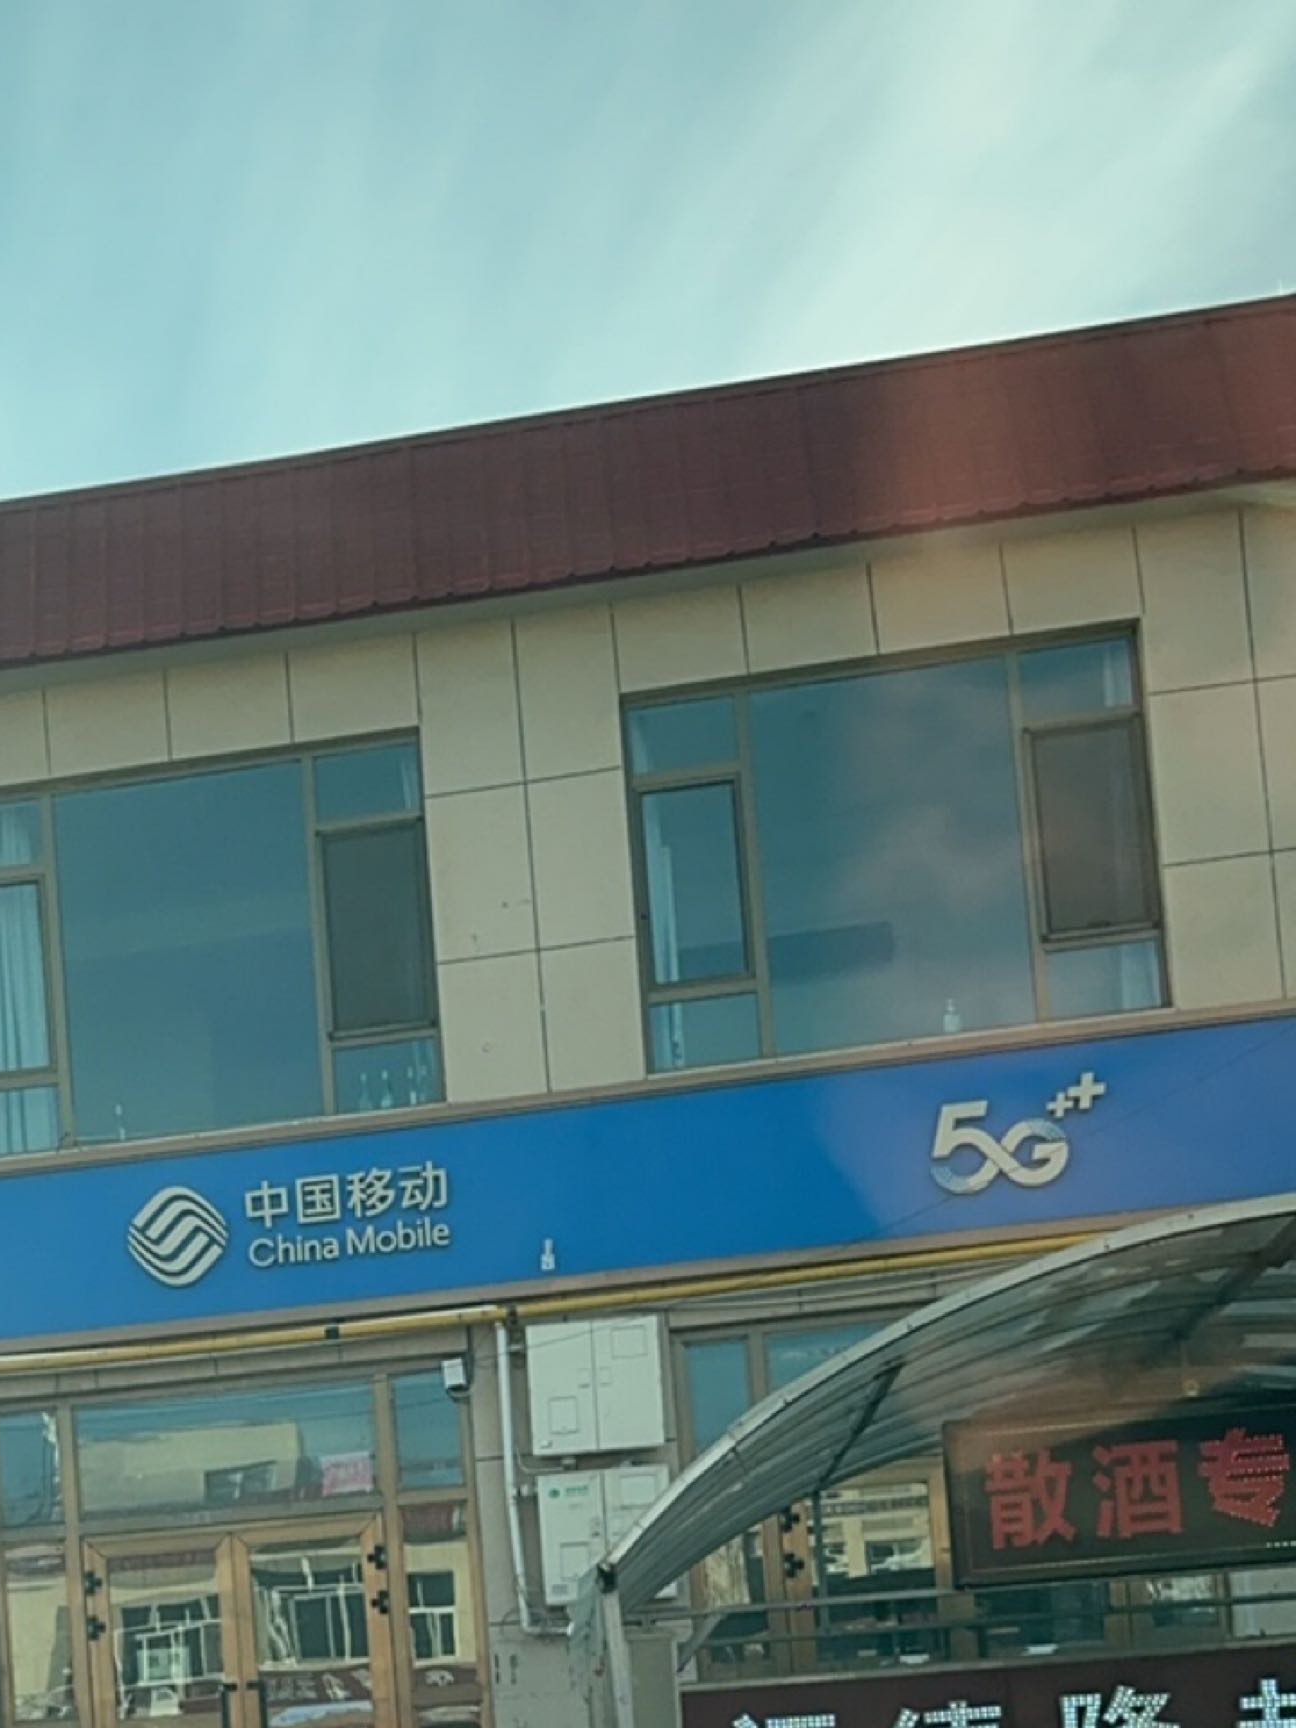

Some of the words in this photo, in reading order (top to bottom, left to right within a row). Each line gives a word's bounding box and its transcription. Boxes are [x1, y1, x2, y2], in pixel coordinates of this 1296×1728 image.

[244, 1160, 448, 1229] 中国移动
[248, 1233, 340, 1268] China
[346, 1216, 451, 1256] Mobile
[983, 1427, 1291, 1551] 散酒专
